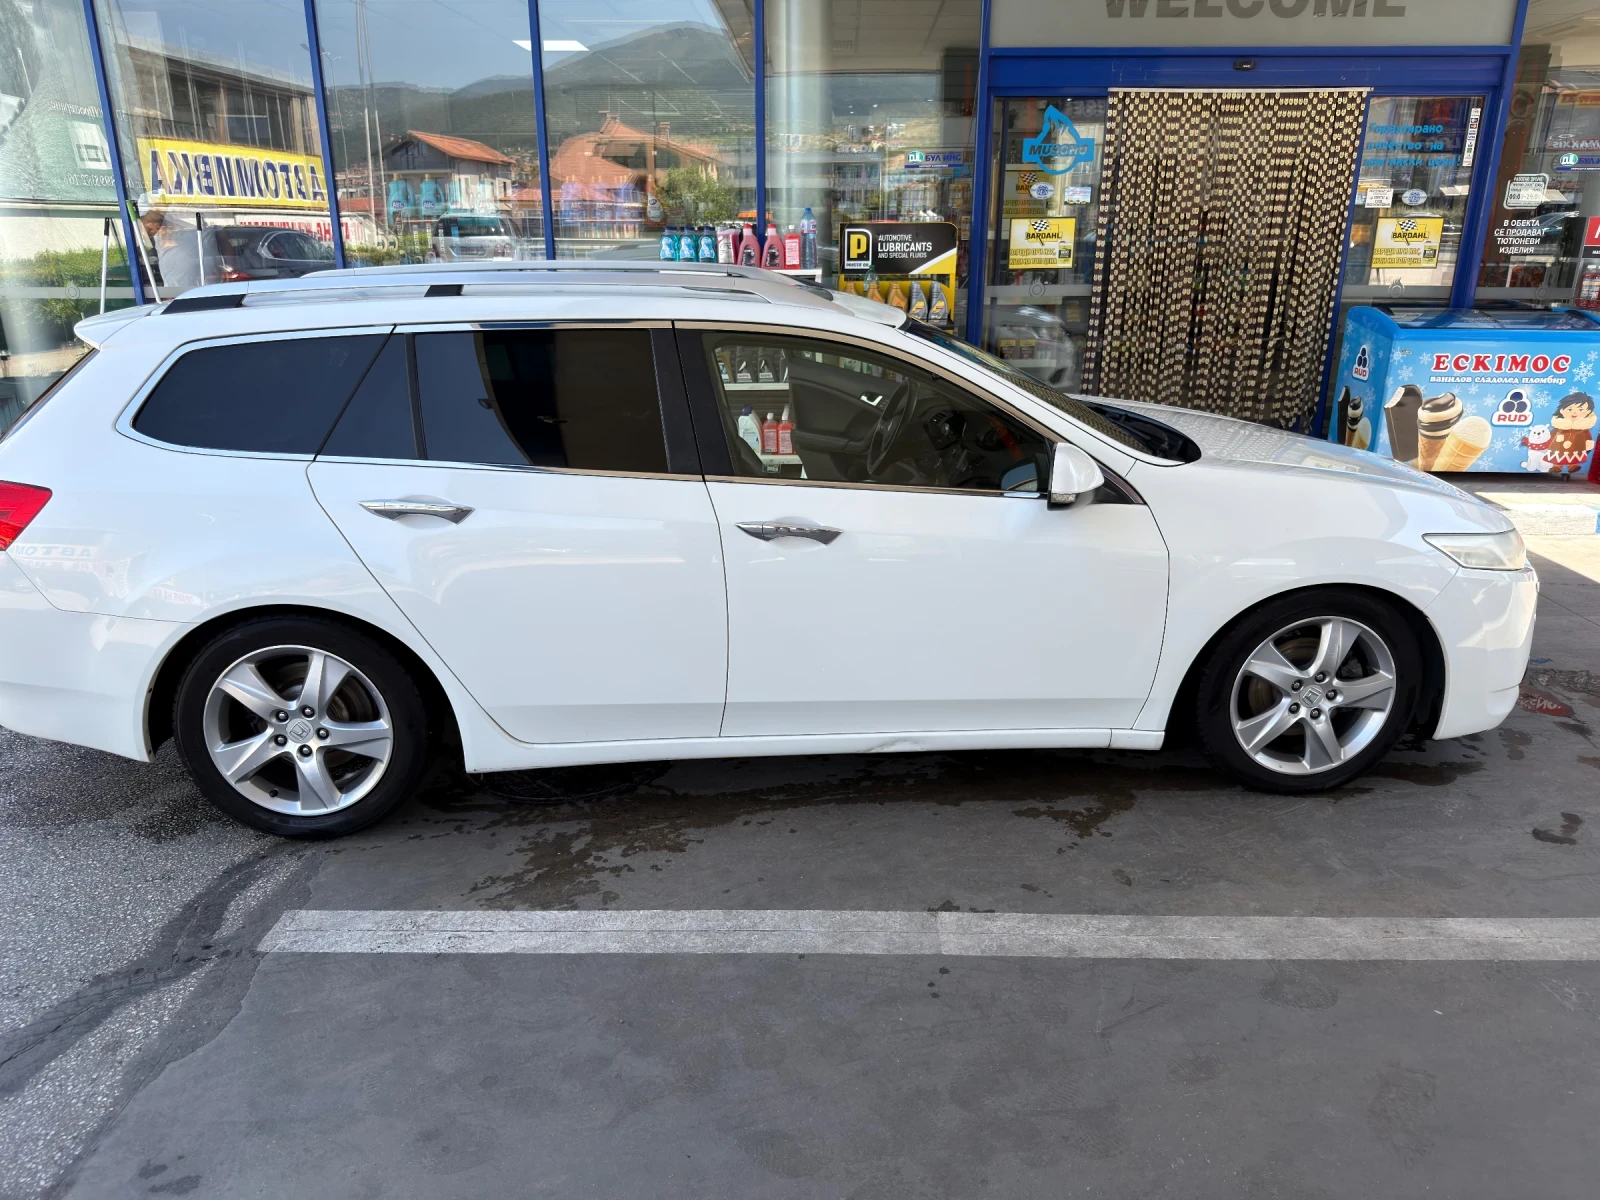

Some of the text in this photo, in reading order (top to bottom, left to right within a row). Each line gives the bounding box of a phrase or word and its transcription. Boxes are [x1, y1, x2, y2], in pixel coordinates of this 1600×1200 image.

[1430, 142, 1444, 150] на
[1511, 219, 1540, 227] ОБЕКТА
[1026, 231, 1062, 240] BARDAHL
[1392, 231, 1428, 240] BARDAHL
[1506, 228, 1546, 237] ПРОДАВАТ
[1497, 237, 1541, 245] ТЮТЮНЕВИ
[878, 242, 933, 252] LUBRICANTS
[1499, 246, 1535, 255] ИЗДЕЛИЯ
[1354, 368, 1368, 377] RUD
[1430, 375, 1567, 385] ванилов сладолед пломбир
[1497, 414, 1528, 423] RUD
